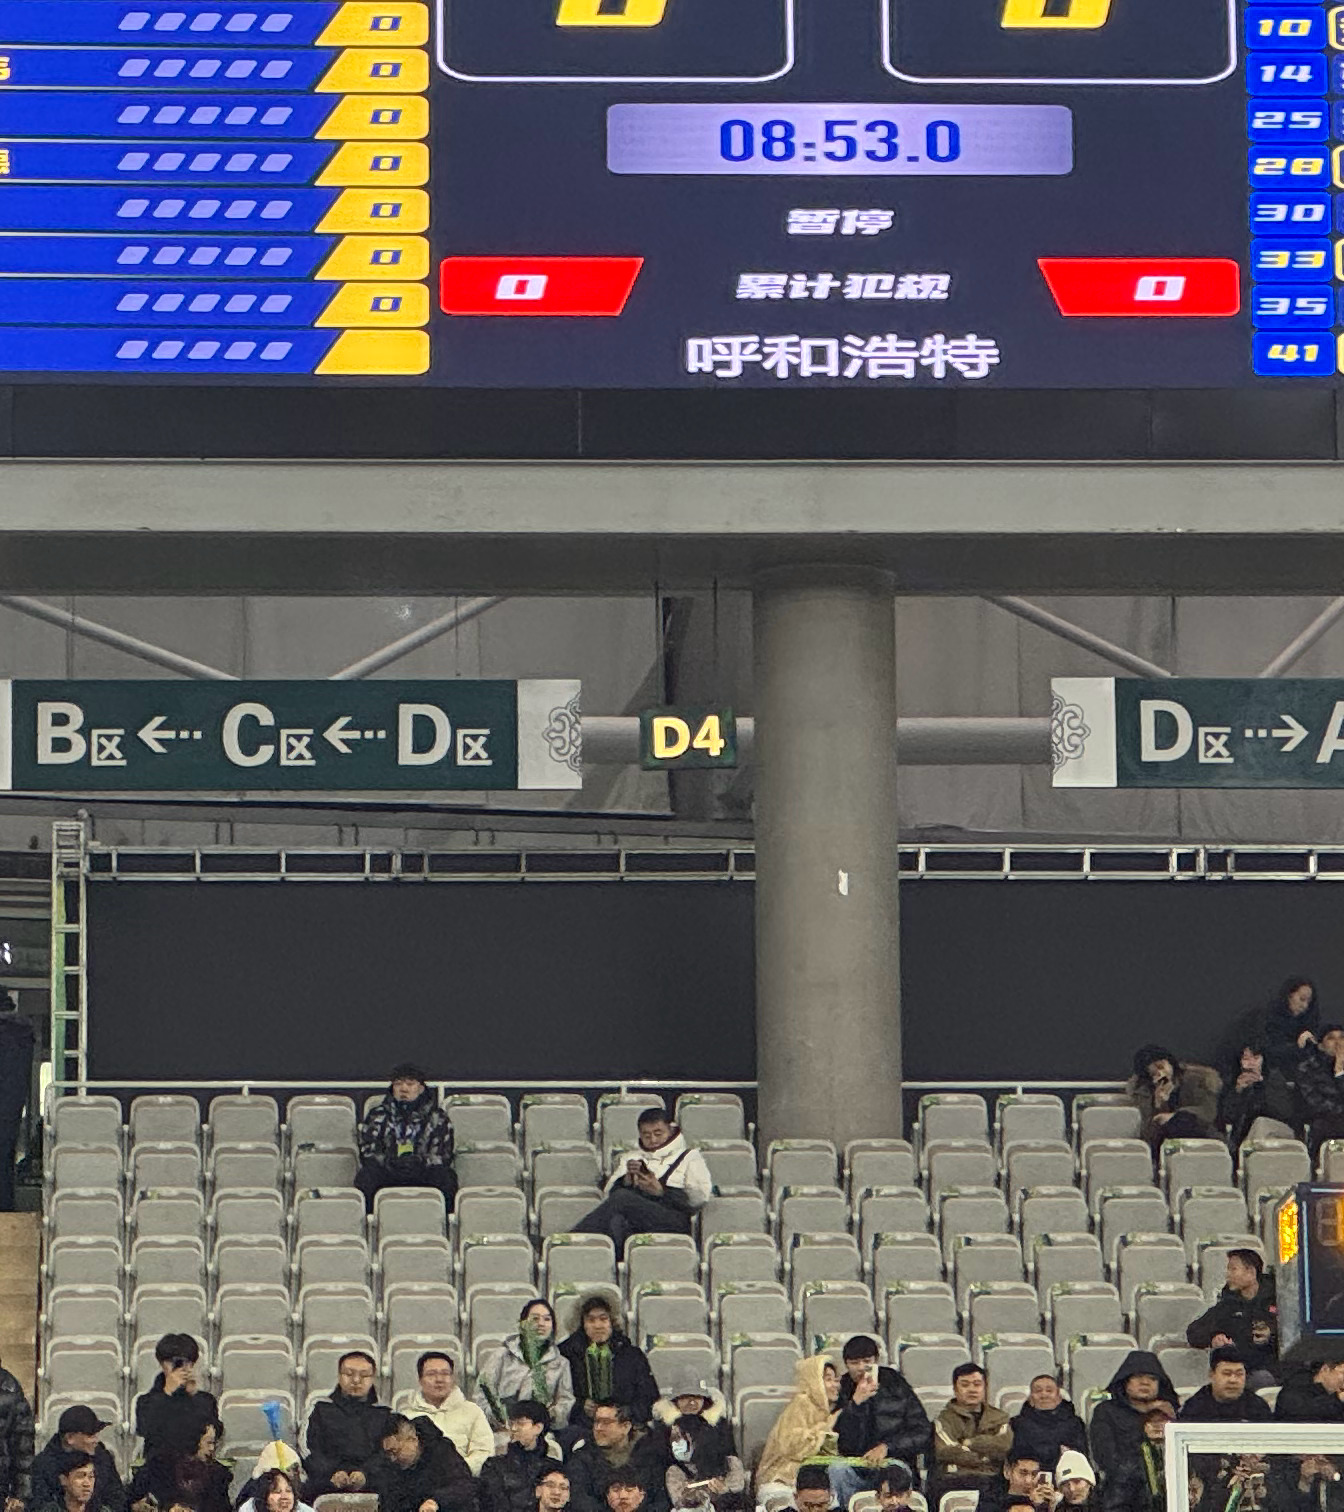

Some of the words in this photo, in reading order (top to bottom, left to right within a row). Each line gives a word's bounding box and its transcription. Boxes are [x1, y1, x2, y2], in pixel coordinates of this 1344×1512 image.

[371, 16, 402, 31] 0
[1259, 19, 1313, 37] 10
[371, 62, 401, 78] 0
[1261, 65, 1312, 83] 14
[370, 109, 402, 125] 0
[1252, 111, 1321, 129] 25
[719, 119, 962, 164] 08:53.0
[370, 155, 401, 171] 0
[1253, 157, 1325, 176] 28
[370, 203, 402, 218] 0
[1254, 204, 1325, 222] 30
[786, 208, 895, 236] 暂停
[371, 249, 401, 265] 0
[1257, 250, 1327, 269] 33
[495, 274, 548, 300] 0
[735, 272, 951, 300] 累计犯规
[1134, 276, 1186, 301] 0
[371, 296, 402, 312] 0
[1257, 297, 1327, 315] 35
[685, 333, 1001, 379] 呼和浩特
[1267, 344, 1319, 363] 41
[652, 715, 725, 759] D4
